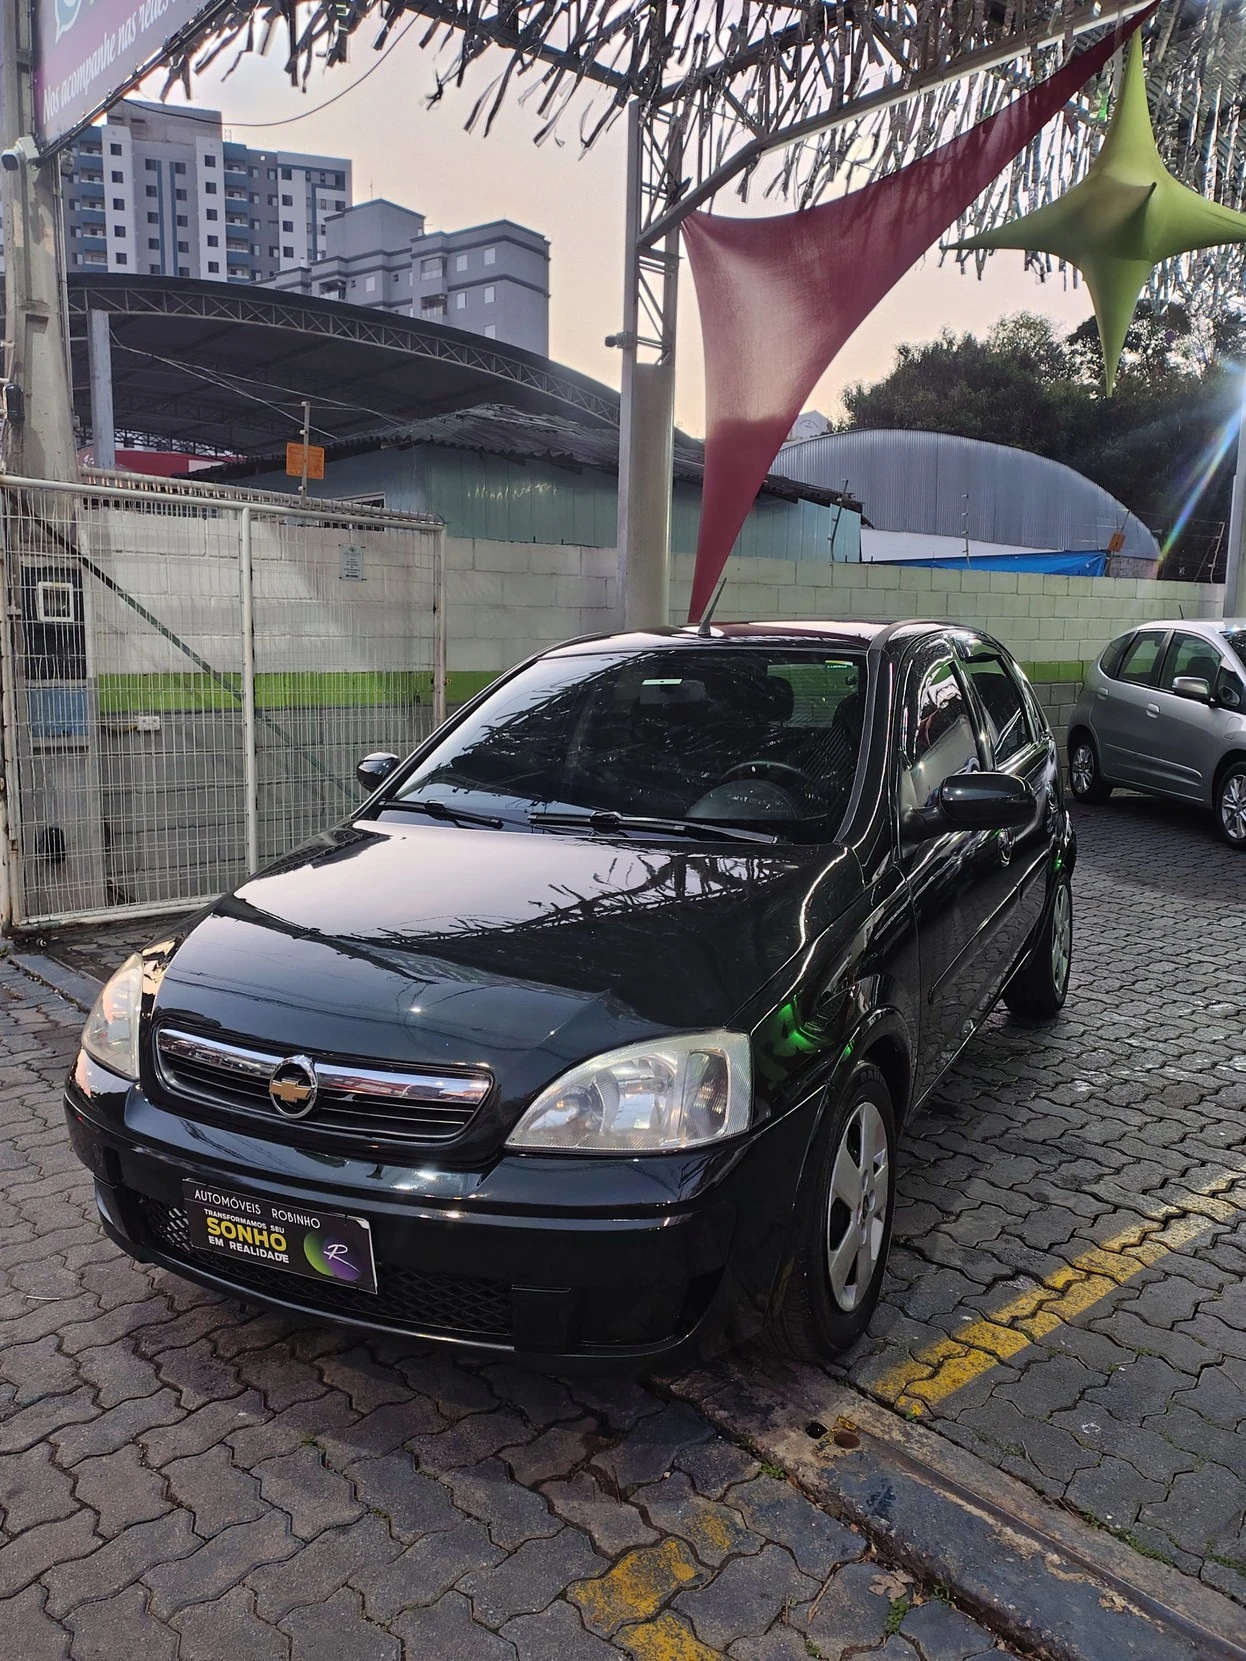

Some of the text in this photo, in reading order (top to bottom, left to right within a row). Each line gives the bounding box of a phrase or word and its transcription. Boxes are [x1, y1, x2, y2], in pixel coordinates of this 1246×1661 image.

[43, 85, 59, 124] Nos
[61, 32, 115, 108] acompanhe
[117, 11, 138, 55] nas
[194, 1189, 321, 1229] AUTOMÓVEIS ROBINHO
[204, 1208, 285, 1234] TRANSFORMAMOS SEU
[206, 1217, 287, 1252] SONHO
[208, 1235, 290, 1264] EM REALIDADE
